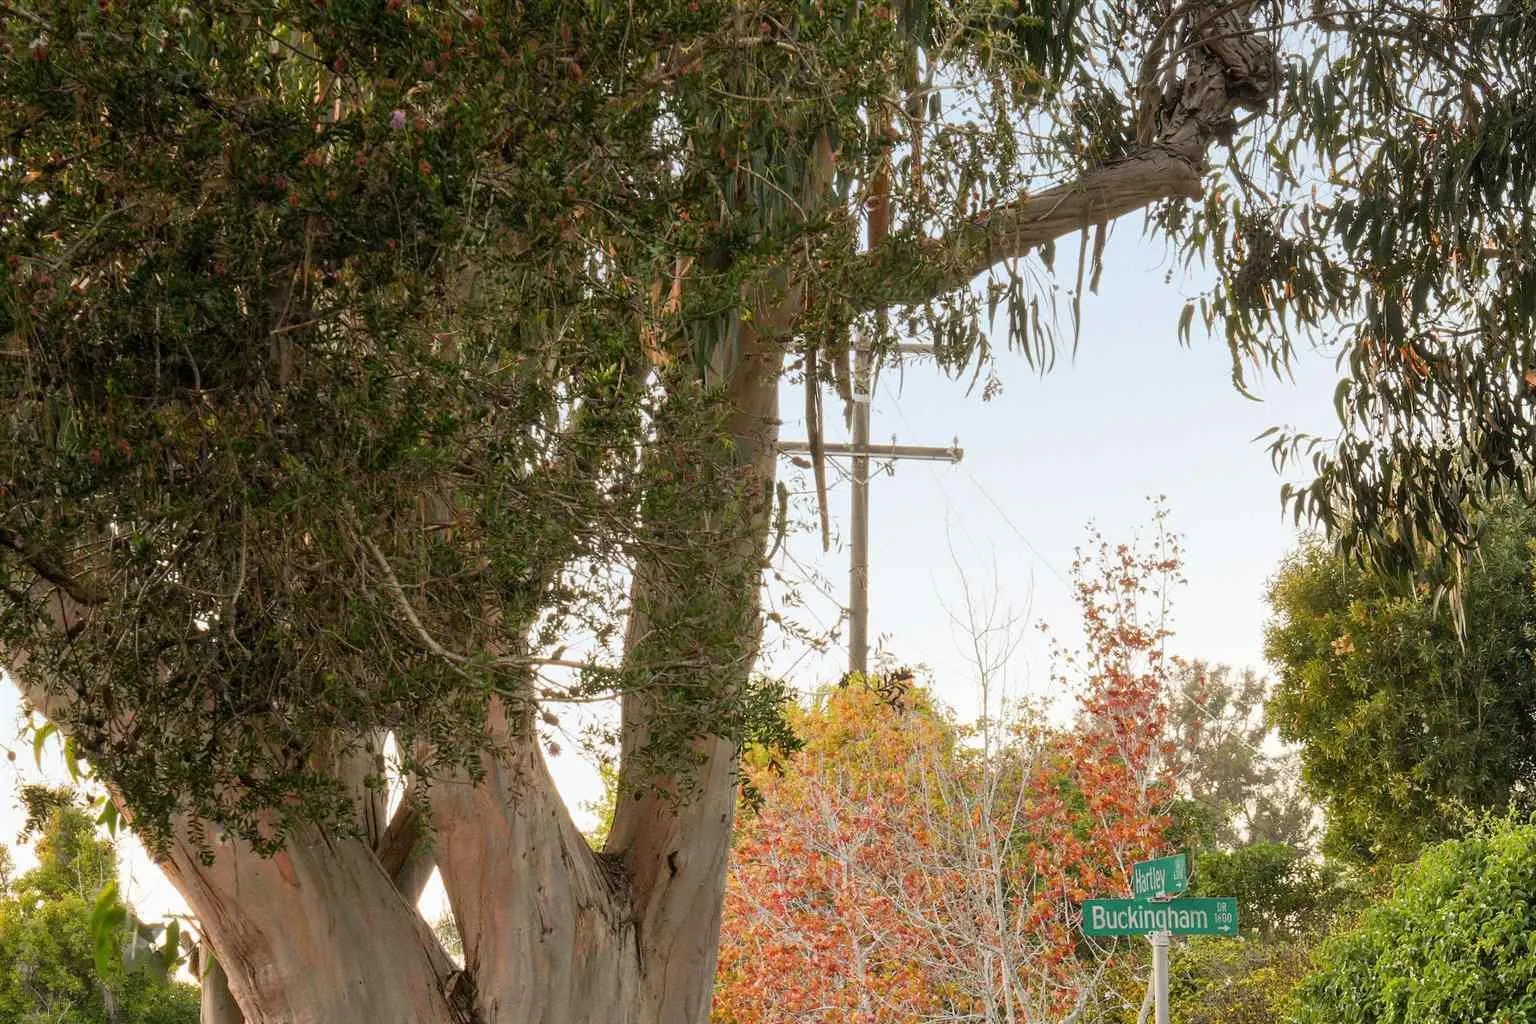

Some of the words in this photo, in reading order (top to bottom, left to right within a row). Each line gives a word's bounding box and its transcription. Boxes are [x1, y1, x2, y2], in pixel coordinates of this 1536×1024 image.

[1135, 867, 1166, 894] Hartley
[1091, 905, 1208, 933] Buckingham
[1216, 902, 1227, 912] DR
